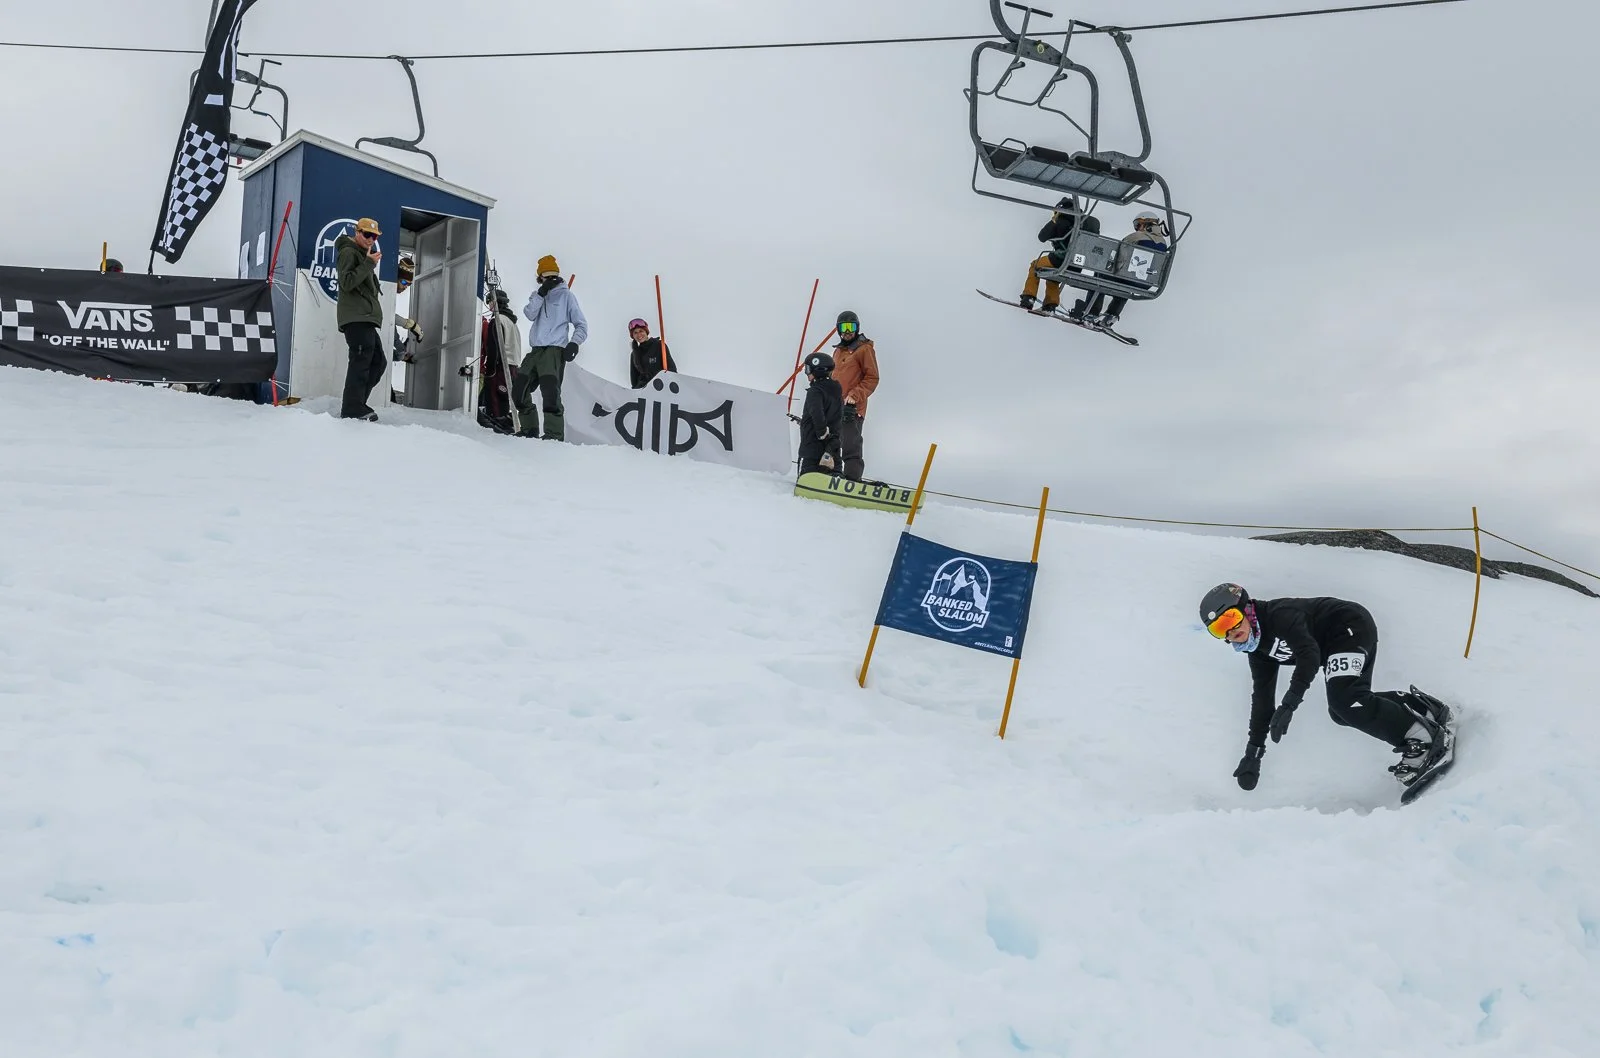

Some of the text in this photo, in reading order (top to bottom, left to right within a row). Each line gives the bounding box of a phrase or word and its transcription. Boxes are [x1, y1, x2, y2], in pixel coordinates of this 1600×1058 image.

[57, 300, 154, 332] VANS
[42, 334, 170, 351] "OFF THE WALL"
[828, 475, 911, 503] BURTON
[927, 594, 973, 610] BANKED
[938, 608, 985, 624] SLALOM
